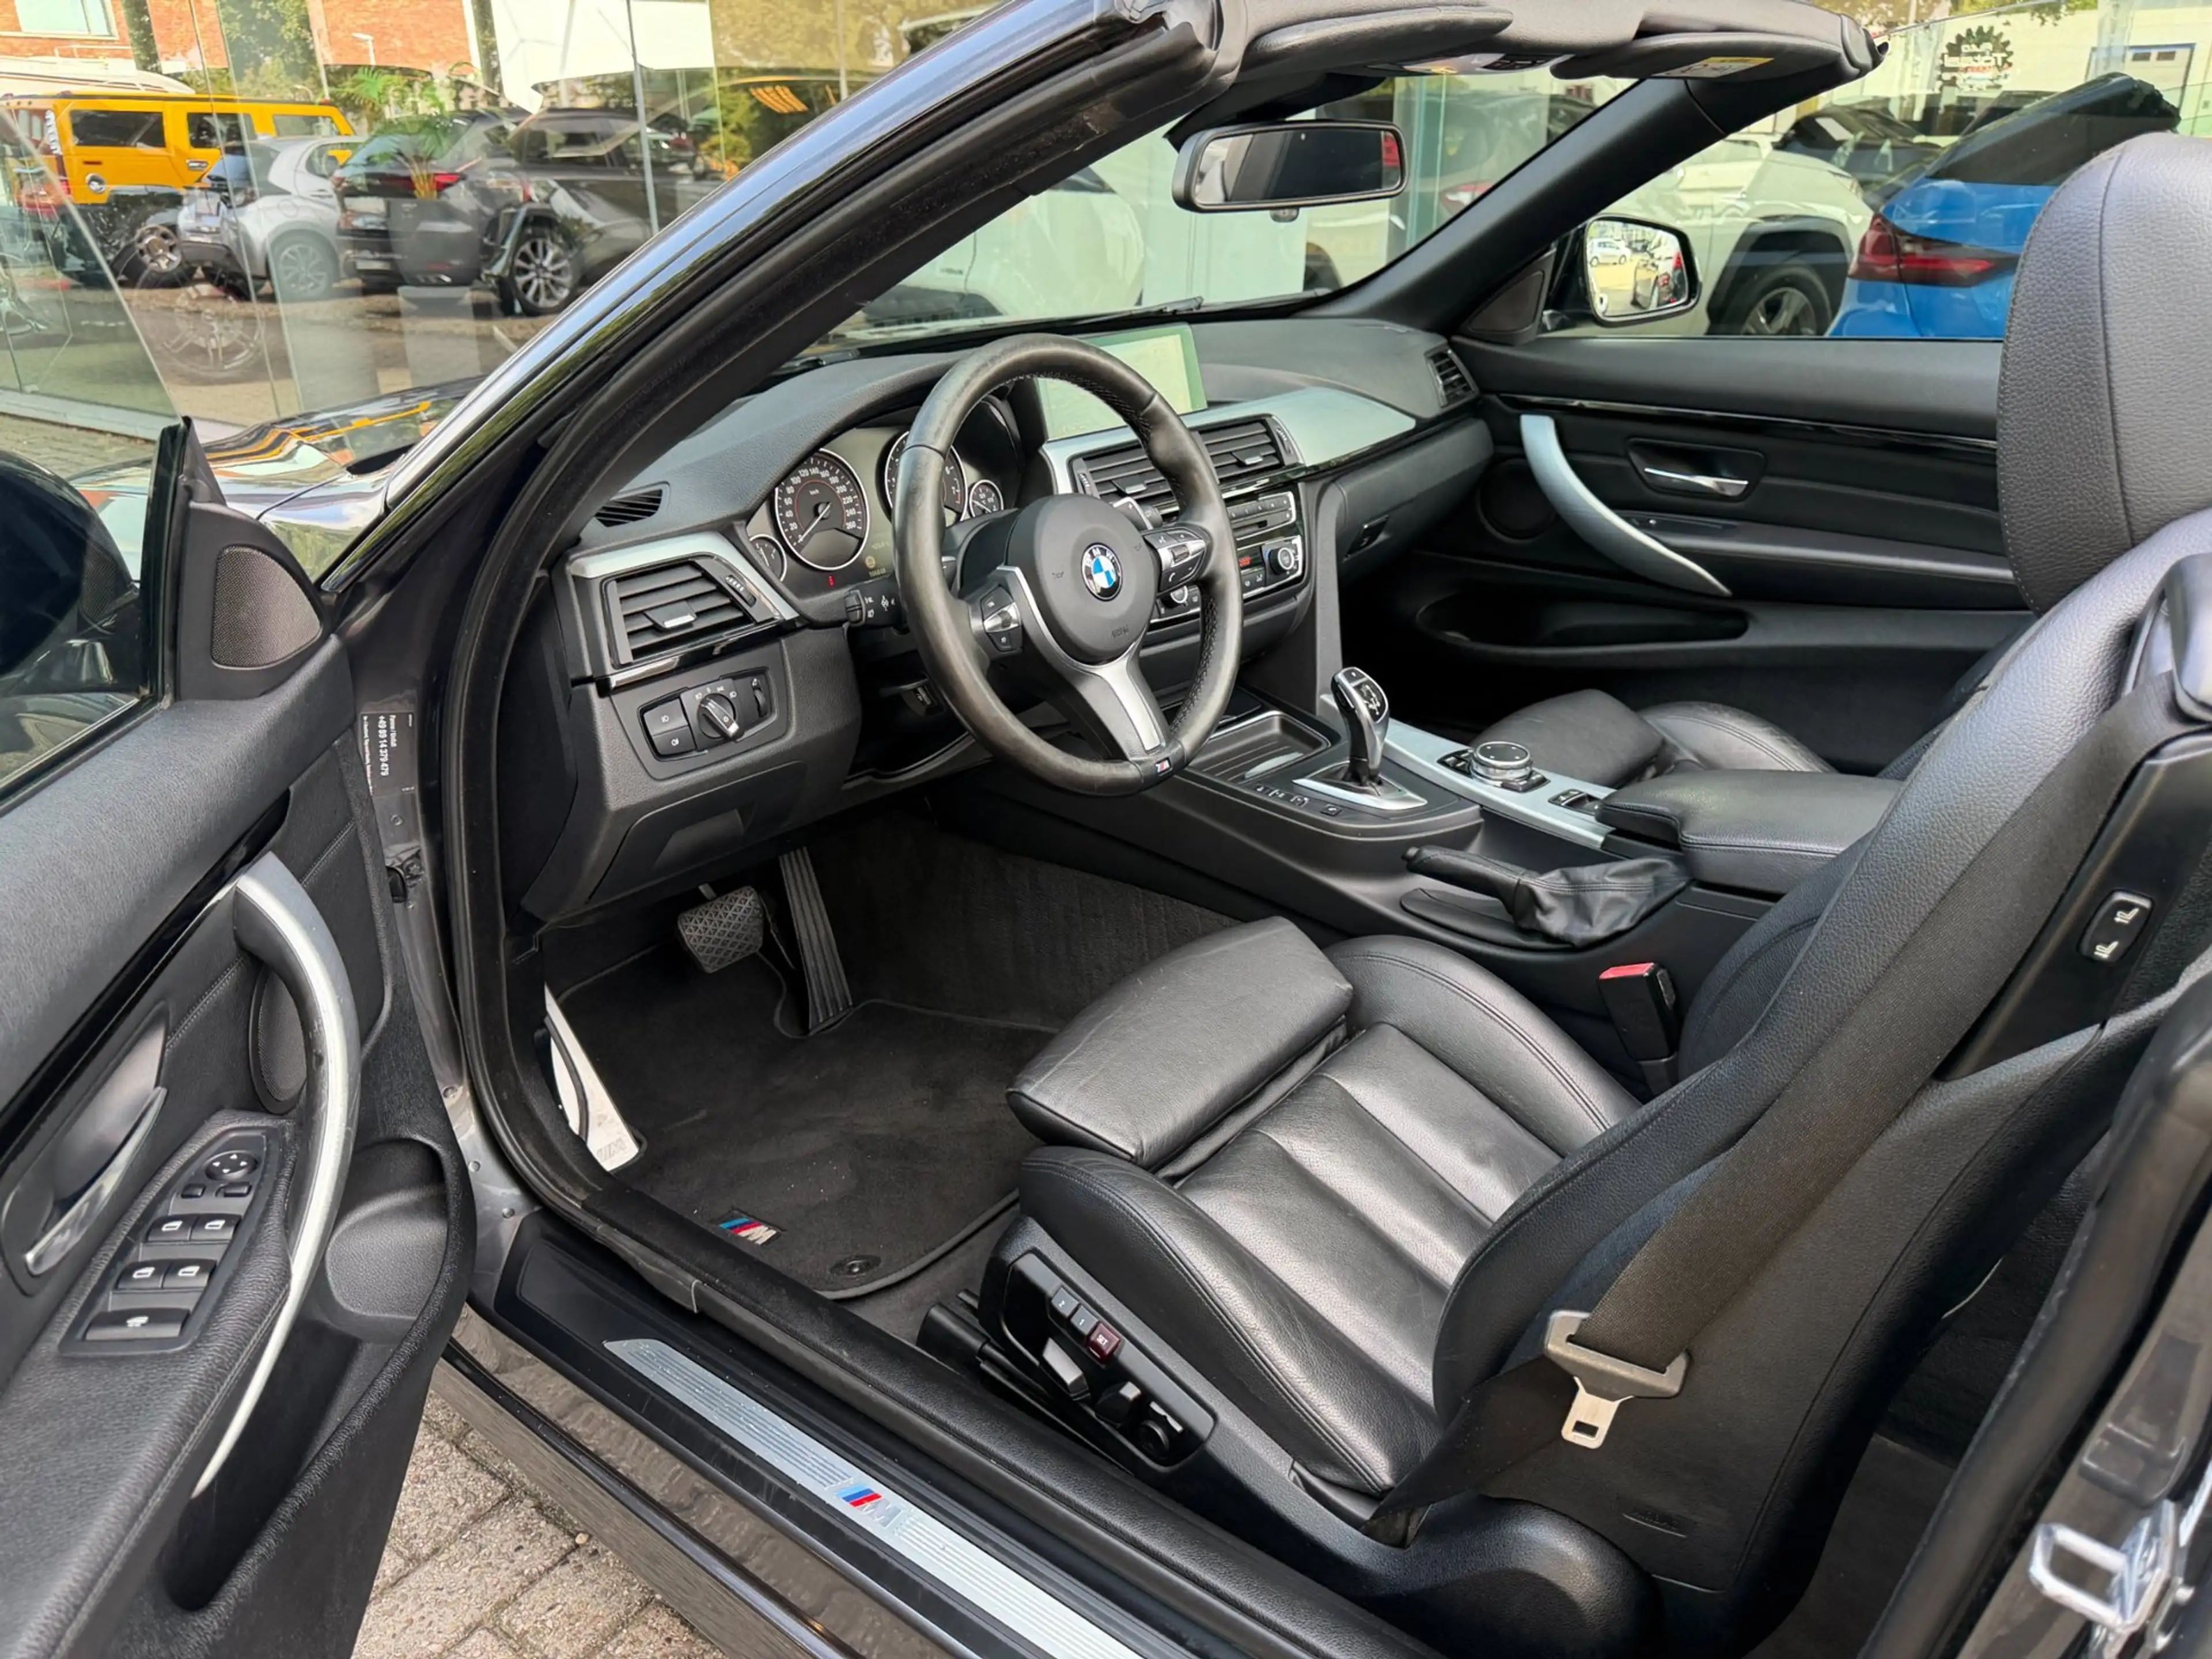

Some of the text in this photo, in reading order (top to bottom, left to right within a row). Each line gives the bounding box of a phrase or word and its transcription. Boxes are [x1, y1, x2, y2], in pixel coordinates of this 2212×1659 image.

[798, 468, 809, 477] 120
[790, 476, 801, 484] 100
[786, 486, 794, 494] 80
[836, 485, 847, 494] 200
[784, 497, 793, 505] 60
[843, 496, 853, 504] 220
[785, 510, 793, 518] 40
[845, 508, 856, 517] 240
[789, 522, 798, 531] 20
[379, 739, 388, 748] 14
